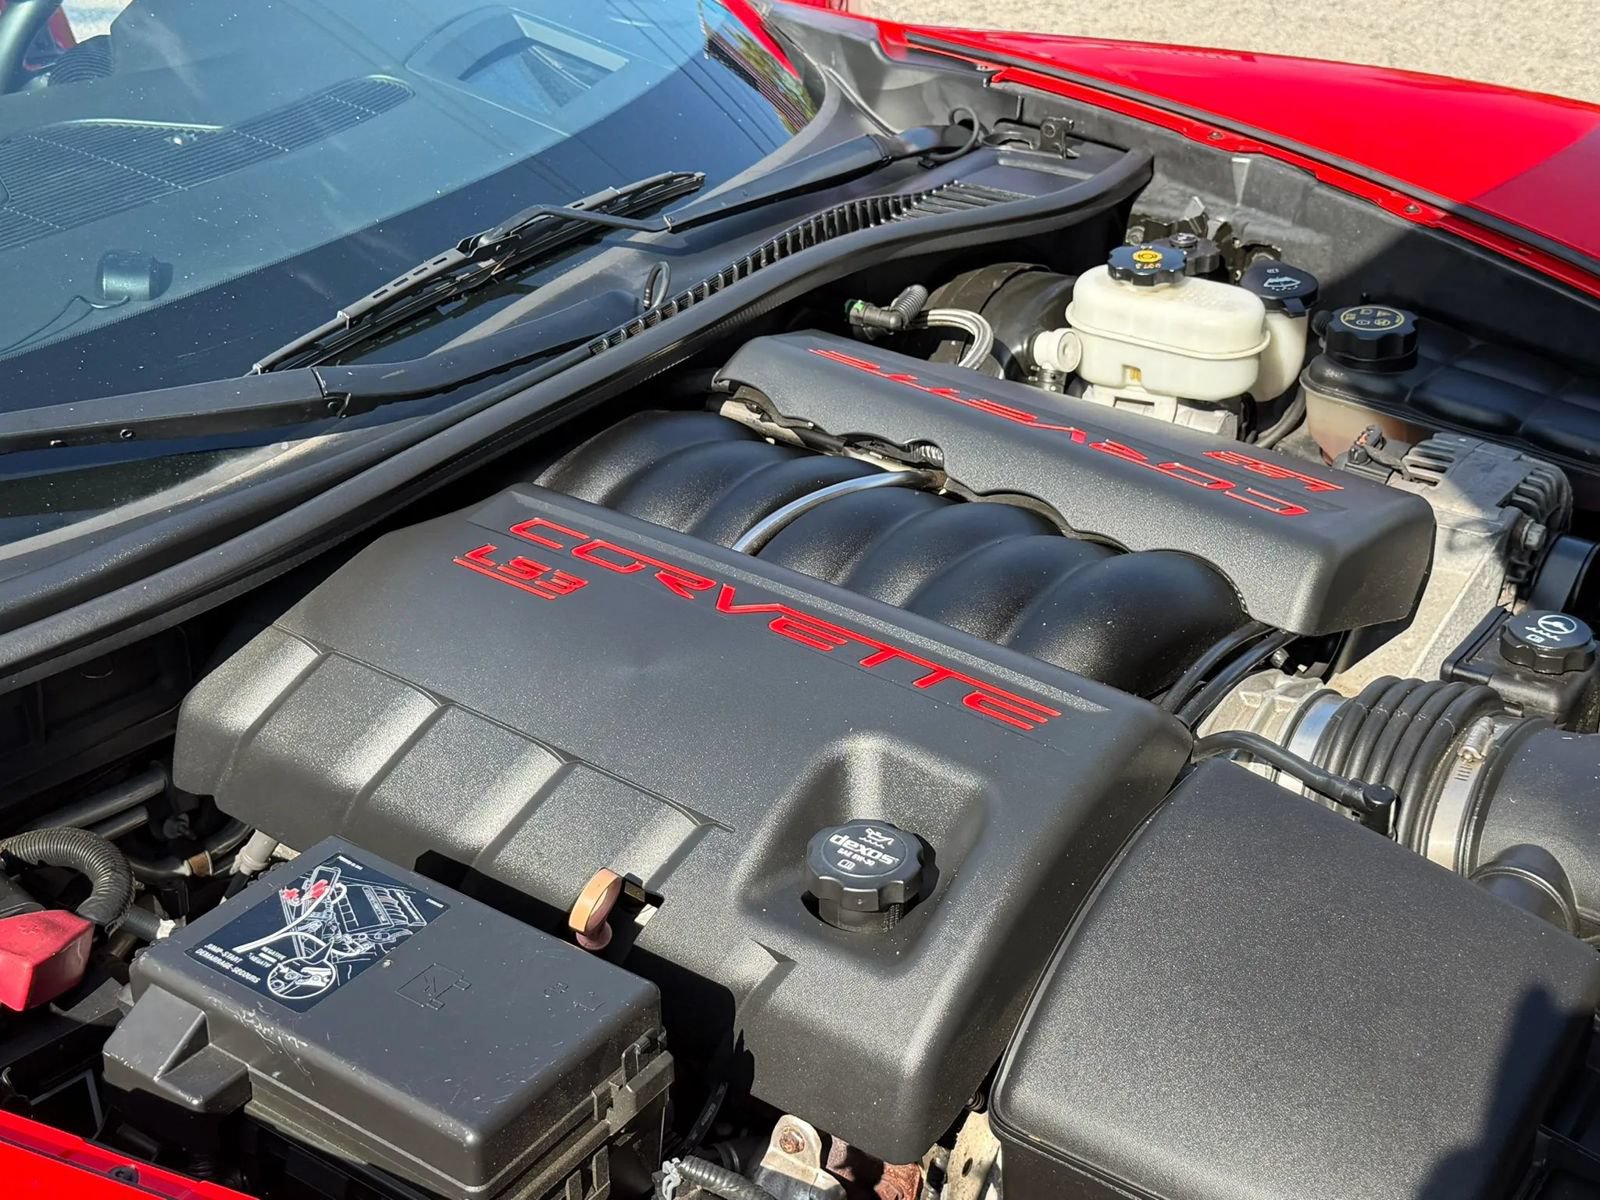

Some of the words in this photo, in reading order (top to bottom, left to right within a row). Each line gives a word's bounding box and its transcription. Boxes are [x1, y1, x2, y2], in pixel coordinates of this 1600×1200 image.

[808, 348, 1309, 516] CORVETTE
[454, 543, 589, 600] LS3
[509, 517, 1062, 731] CORVETTE
